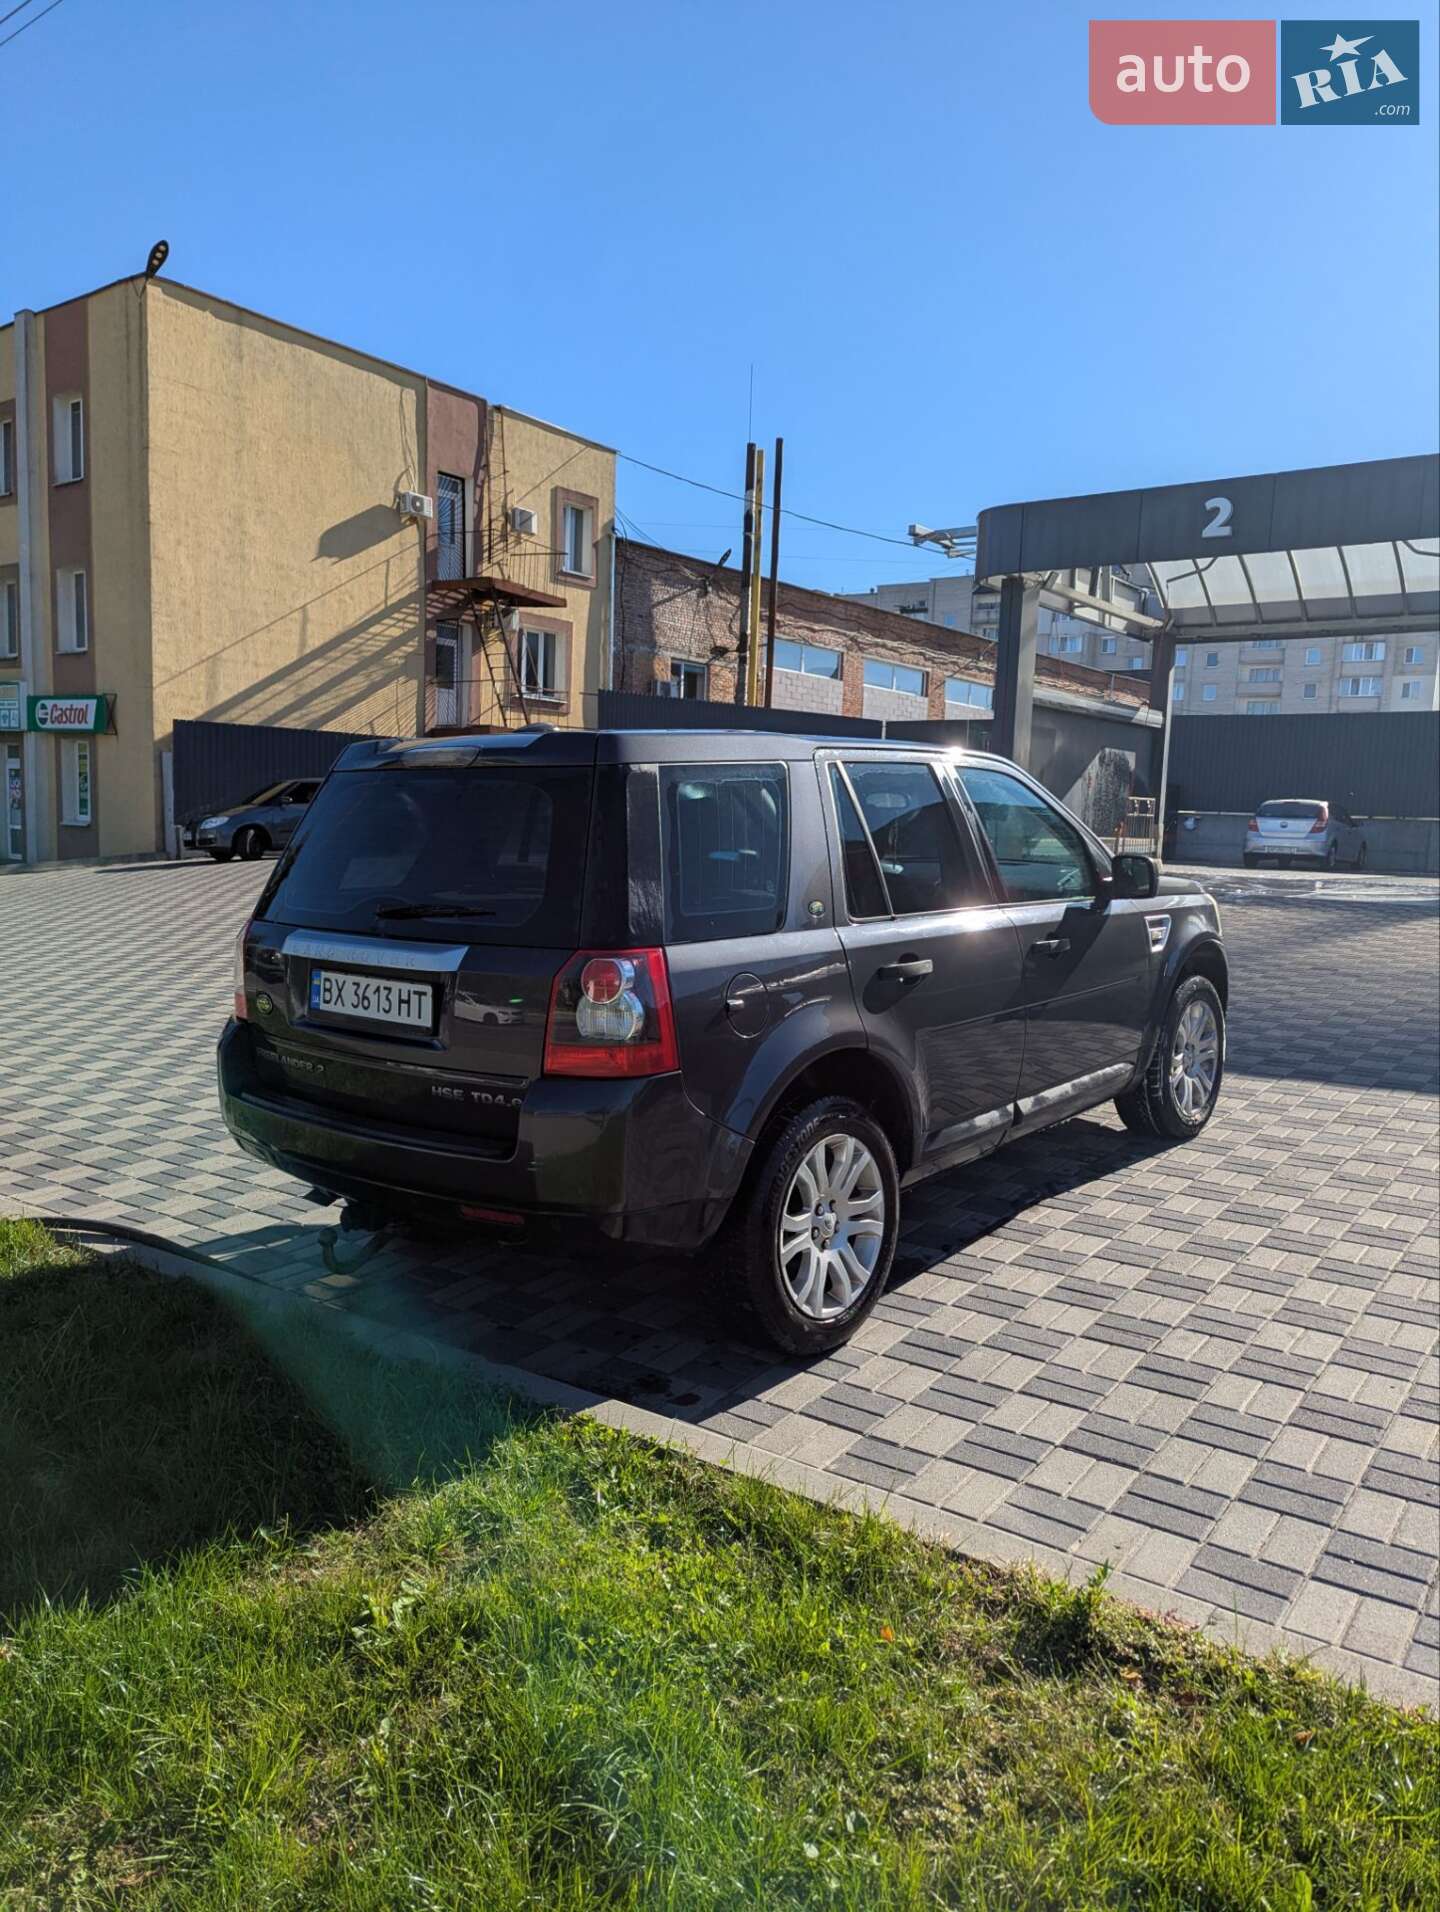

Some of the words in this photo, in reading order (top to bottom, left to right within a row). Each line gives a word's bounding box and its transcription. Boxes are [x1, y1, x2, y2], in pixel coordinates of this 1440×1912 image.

[1201, 497, 1233, 538] 2
[50, 702, 89, 725] Castrol
[322, 977, 346, 1007] BX
[351, 981, 392, 1014] 3613
[398, 988, 427, 1019] HT
[431, 1085, 465, 1101] HSE
